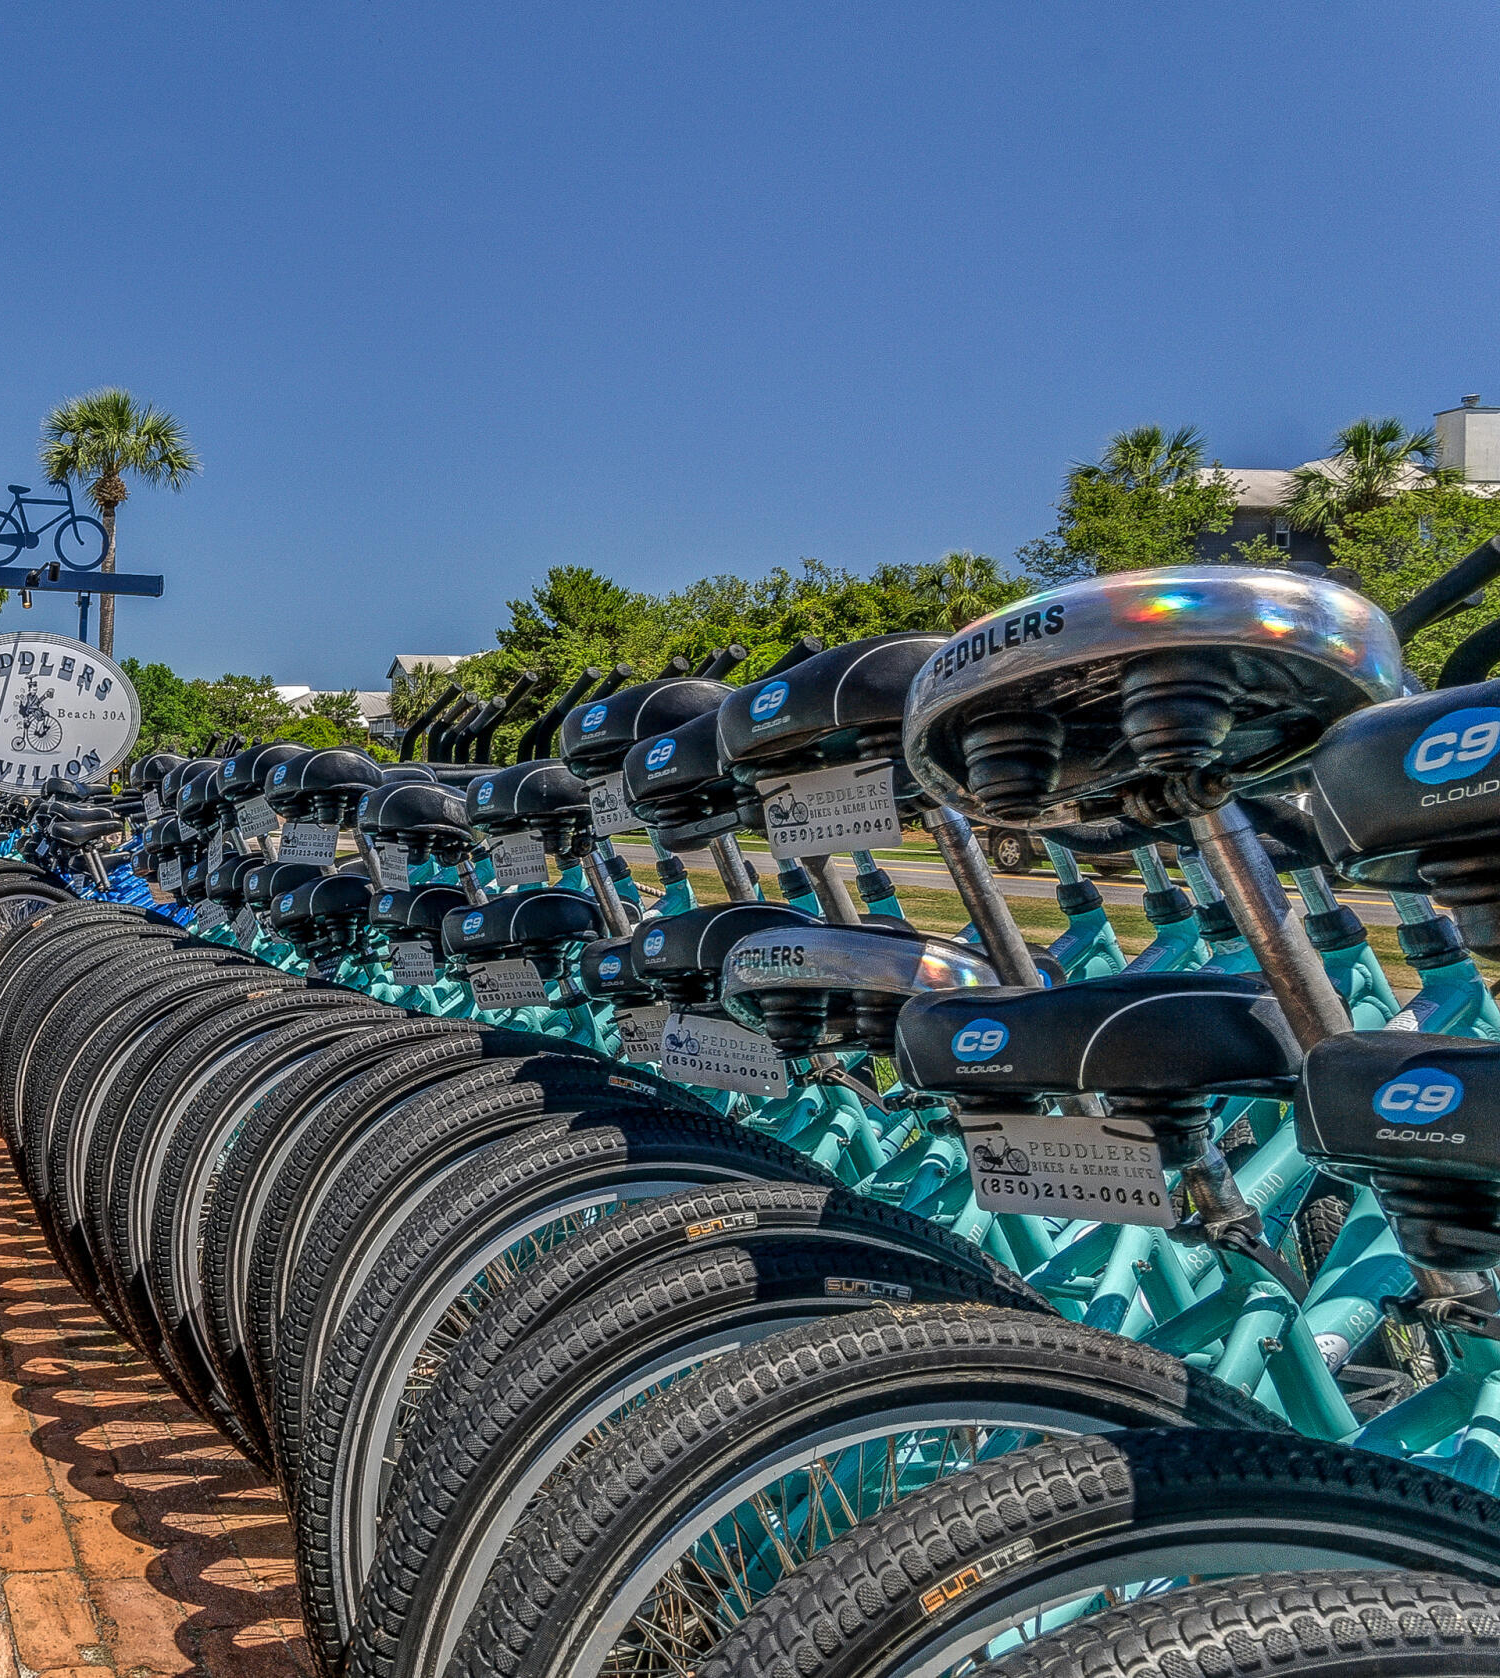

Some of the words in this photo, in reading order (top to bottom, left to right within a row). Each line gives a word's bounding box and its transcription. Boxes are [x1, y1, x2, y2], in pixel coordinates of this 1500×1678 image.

[933, 604, 1065, 682] PEDDLERS
[753, 688, 786, 714] C9
[57, 708, 96, 720] Beach
[102, 711, 126, 721] 30A
[647, 744, 674, 765] C9
[1414, 720, 1500, 772] C9
[805, 781, 889, 807] PEDDLERS
[810, 807, 832, 819] BIKES
[834, 805, 841, 815] &
[842, 802, 867, 815] BEACH
[869, 799, 890, 811] LIFE
[774, 817, 894, 848] (850)213-0040
[462, 915, 483, 930] C9
[956, 1031, 1004, 1052] C9
[665, 1054, 780, 1081] (850)213-0040
[1381, 1083, 1456, 1112] C9
[1376, 1128, 1467, 1144] CLOUD-9
[1027, 1141, 1152, 1164] PEDDLERS
[1031, 1161, 1065, 1174] BIKES
[1069, 1163, 1079, 1174] &
[1083, 1164, 1121, 1177] BEACH
[1124, 1166, 1157, 1180] LIFE
[980, 1178, 1161, 1208] (850)213-0040
[687, 1214, 756, 1238] SUNLITE
[922, 1539, 1034, 1613] SUNLITE
